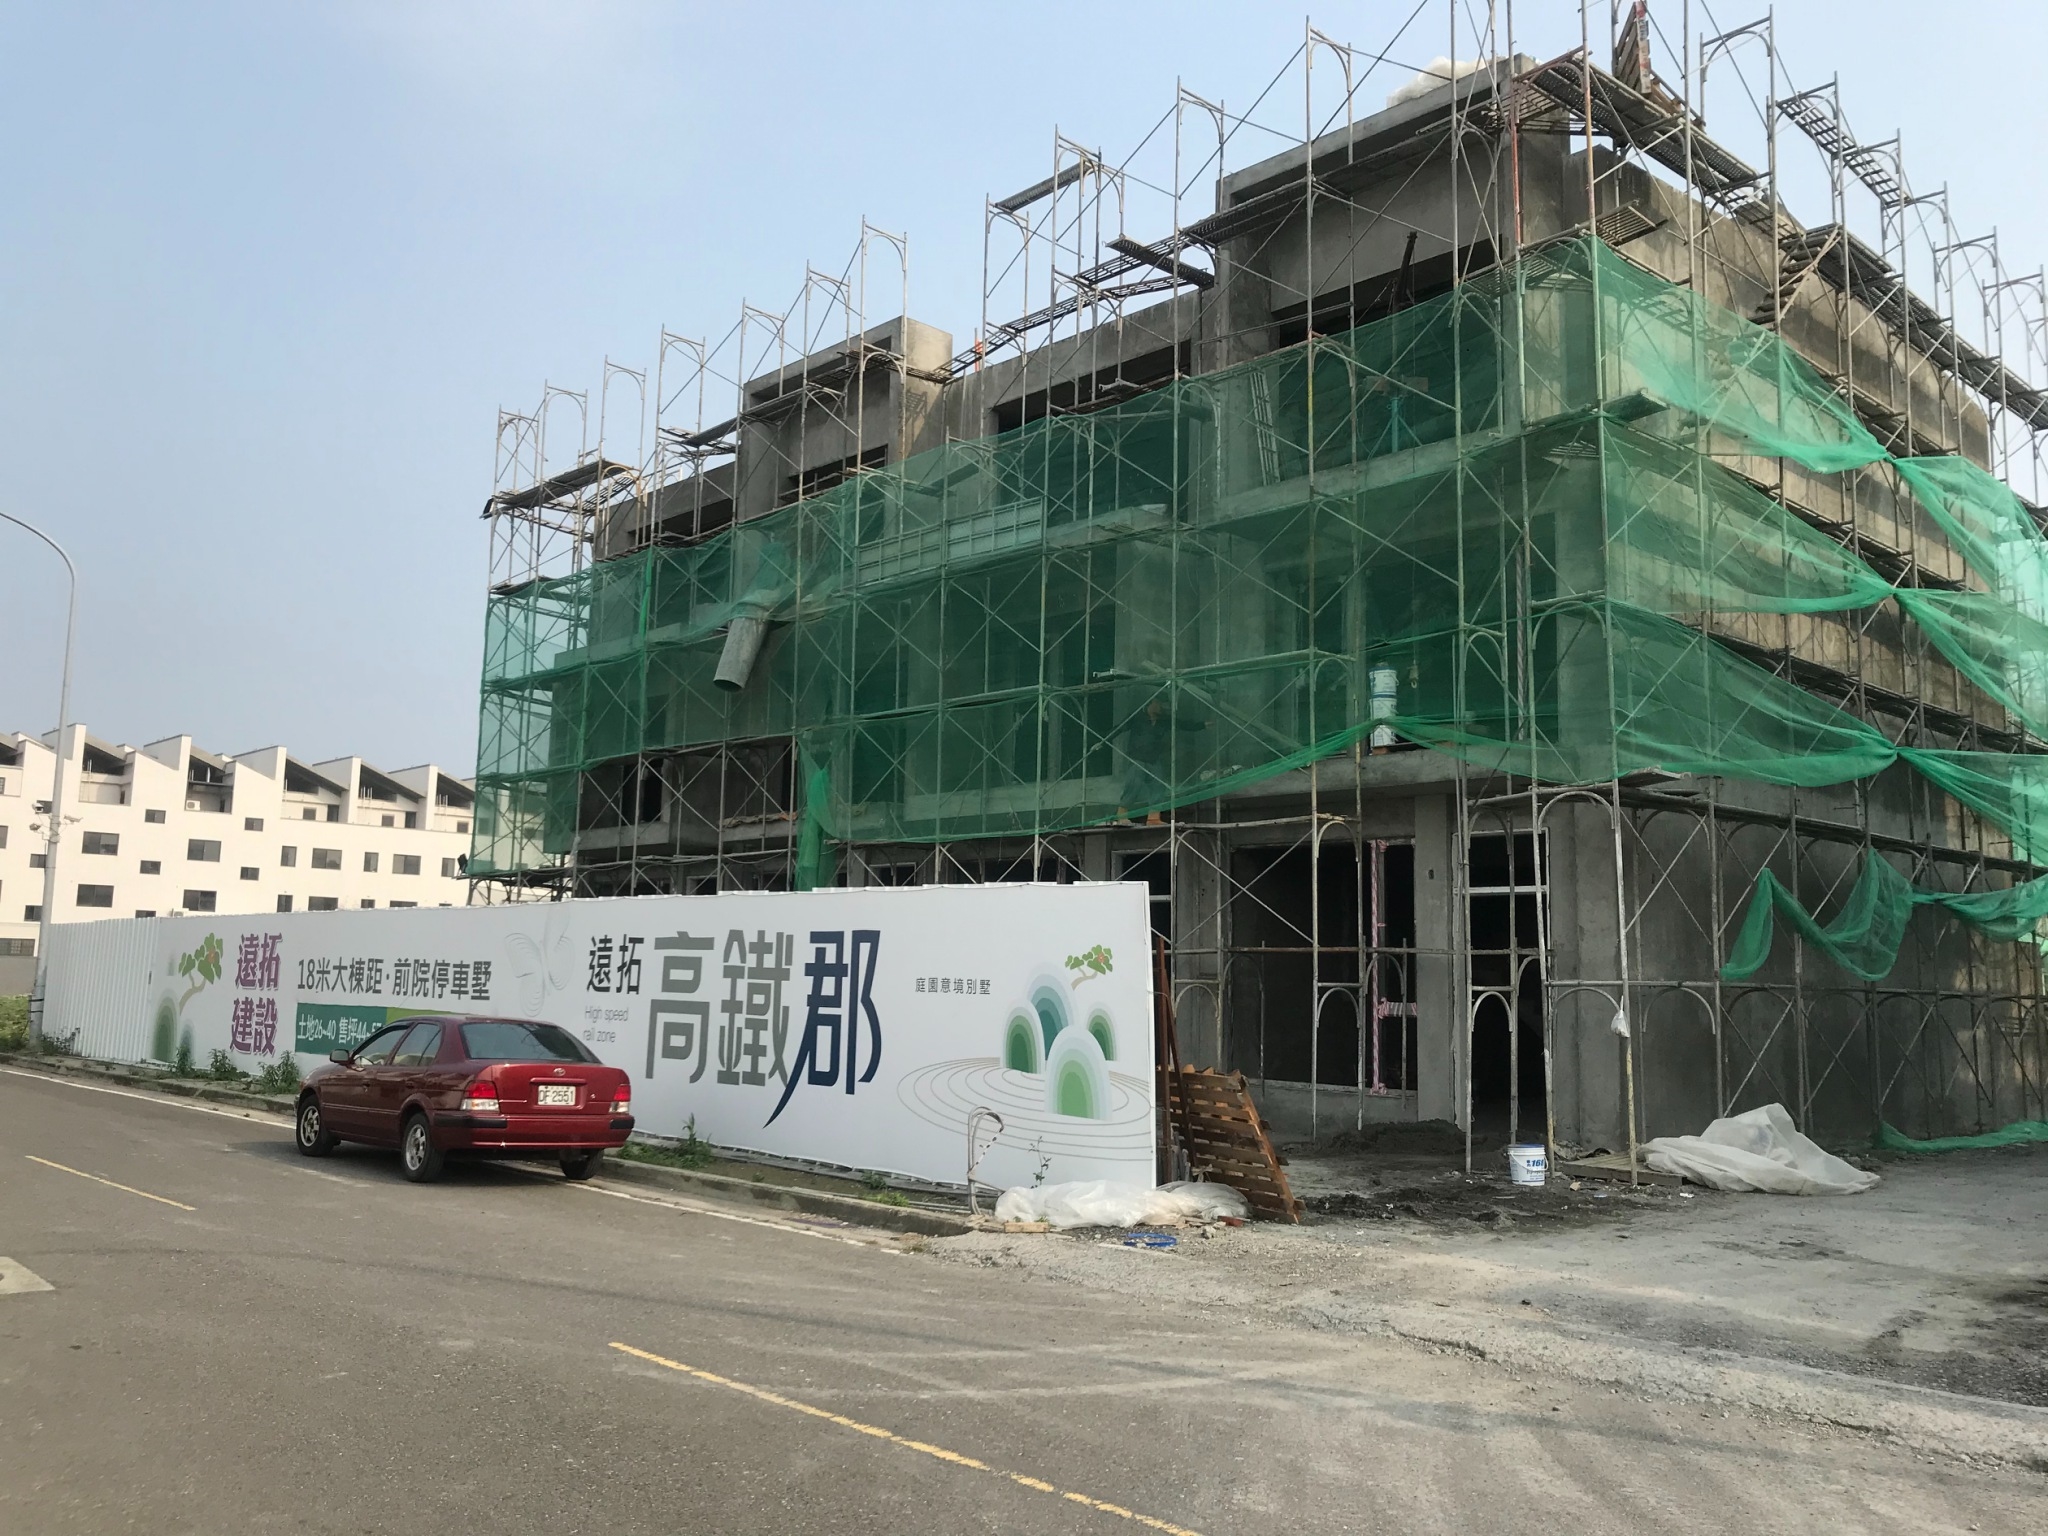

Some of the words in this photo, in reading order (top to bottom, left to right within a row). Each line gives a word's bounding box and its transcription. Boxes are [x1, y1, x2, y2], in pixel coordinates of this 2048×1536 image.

[235, 932, 282, 990] 遠拓
[586, 933, 645, 995] 遠拓
[915, 977, 991, 995] 庭園意境別墅
[230, 996, 277, 1057] 建設
[583, 1028, 595, 1041] rail
[596, 1031, 616, 1043] zone
[584, 1005, 602, 1023] High
[604, 1007, 629, 1022] speed
[645, 929, 882, 1129] 高鐵郡
